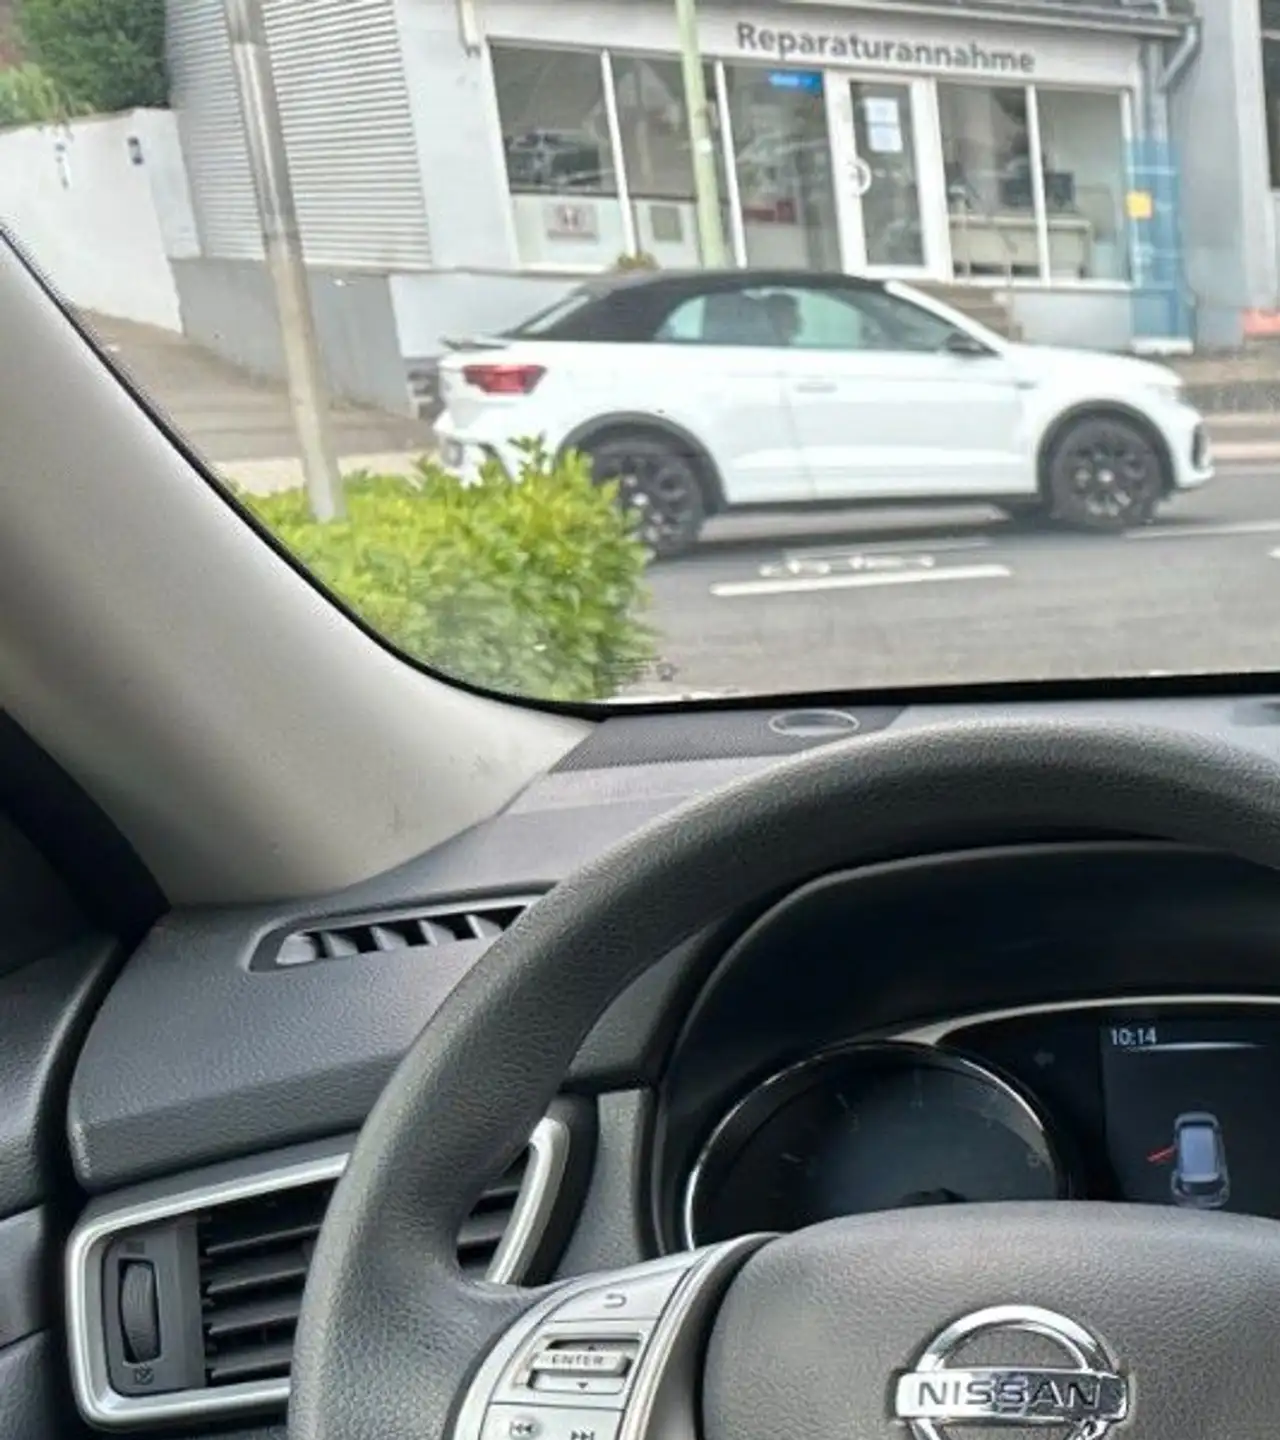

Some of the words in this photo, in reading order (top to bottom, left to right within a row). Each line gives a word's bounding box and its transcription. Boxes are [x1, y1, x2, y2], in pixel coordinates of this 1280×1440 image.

[736, 21, 1036, 73] Reparaturannahme
[1109, 1026, 1158, 1046] 10:14
[550, 1353, 605, 1366] ENTER
[917, 1379, 1100, 1409] NISSAN
